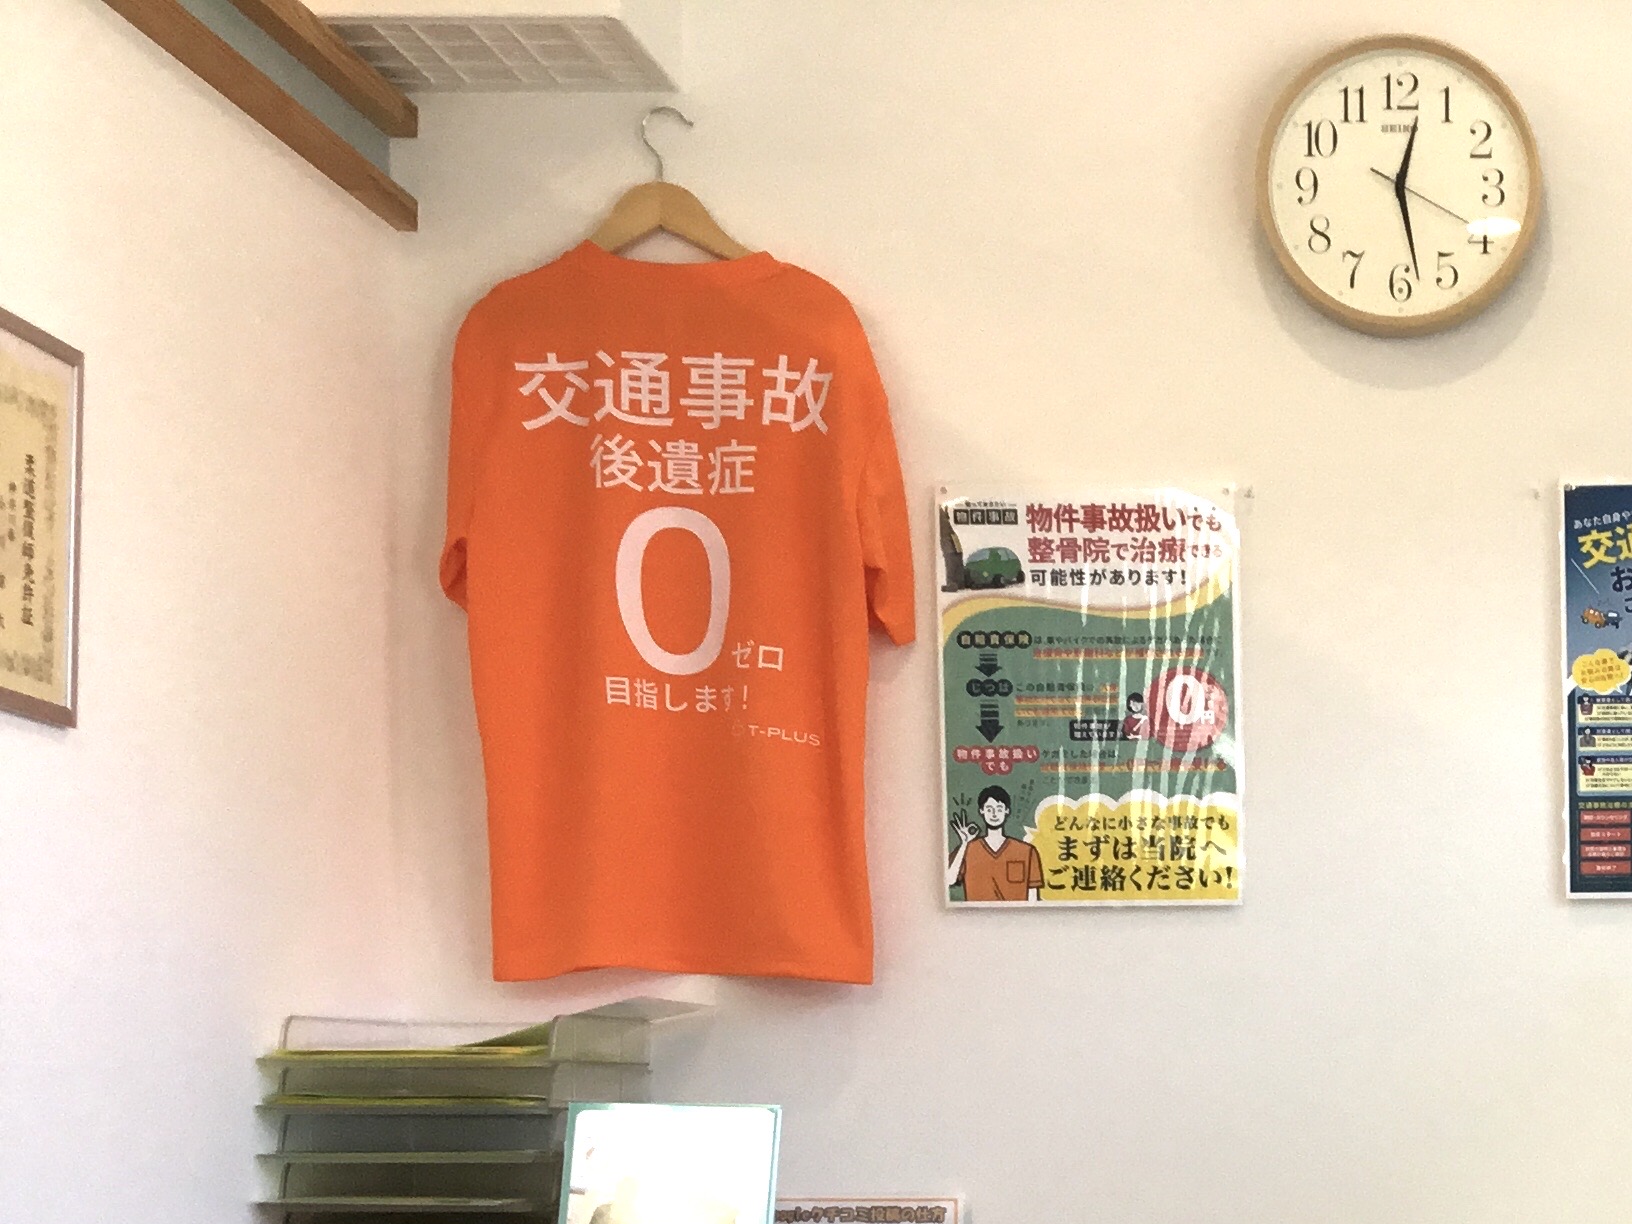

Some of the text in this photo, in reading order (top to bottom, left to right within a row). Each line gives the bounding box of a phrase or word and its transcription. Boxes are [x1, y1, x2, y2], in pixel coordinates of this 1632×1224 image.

[1339, 85, 1367, 123] 11
[1383, 72, 1419, 110] 12
[1441, 86, 1454, 123] 1
[1304, 119, 1338, 157] 10
[1469, 120, 1493, 159] 2
[1295, 167, 1319, 206] 9
[1481, 168, 1505, 207] 3
[1308, 215, 1331, 254] 8
[1342, 250, 1365, 289] 7
[1389, 264, 1412, 302] 6
[1436, 251, 1458, 289] 5
[514, 351, 833, 435] 交通事故
[589, 433, 758, 495] 後遺症
[1025, 503, 1222, 532] 物件事故扱いでも
[1027, 536, 1224, 563] 整骨院で治療できる
[615, 506, 731, 675] 0
[731, 641, 784, 671] ゼロ
[748, 724, 821, 746] T-PLUS
[1053, 816, 1230, 830] どんなに小さな事故でも
[1057, 835, 1227, 861] まずは当院へ
